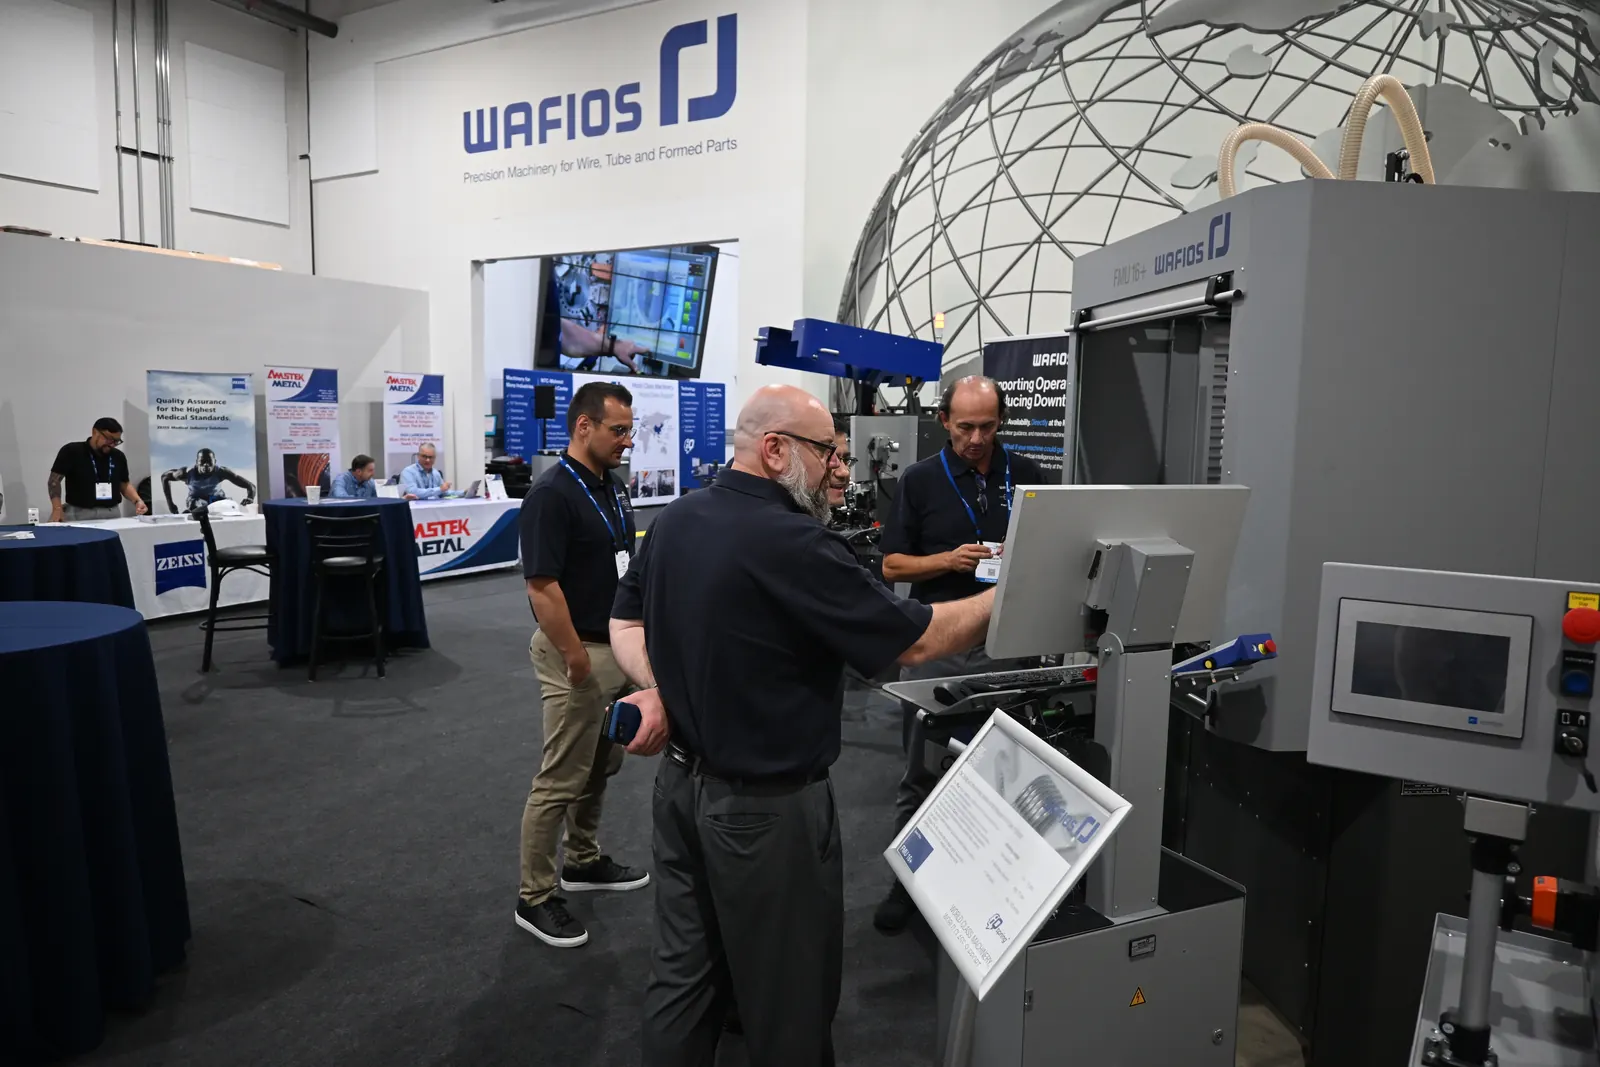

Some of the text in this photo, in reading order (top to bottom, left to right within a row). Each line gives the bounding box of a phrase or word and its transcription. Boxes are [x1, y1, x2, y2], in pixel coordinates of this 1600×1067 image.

[463, 82, 642, 154] WAFIOS
[464, 138, 738, 183] Precision Machinery for Wire, Tube and Formed Parts
[1154, 241, 1204, 275] WAFIOS
[1113, 262, 1147, 288] FMU 16+
[267, 369, 304, 381] AMSTEK
[386, 375, 416, 386] AMSTEK
[272, 380, 302, 388] METAL
[1035, 376, 1066, 393] Opera
[156, 397, 184, 405] Quality
[1033, 393, 1066, 407] Downt
[187, 406, 216, 414] Highest
[190, 414, 231, 422] Standards.
[1031, 418, 1048, 427] Directly
[156, 552, 203, 571] ZEISS
